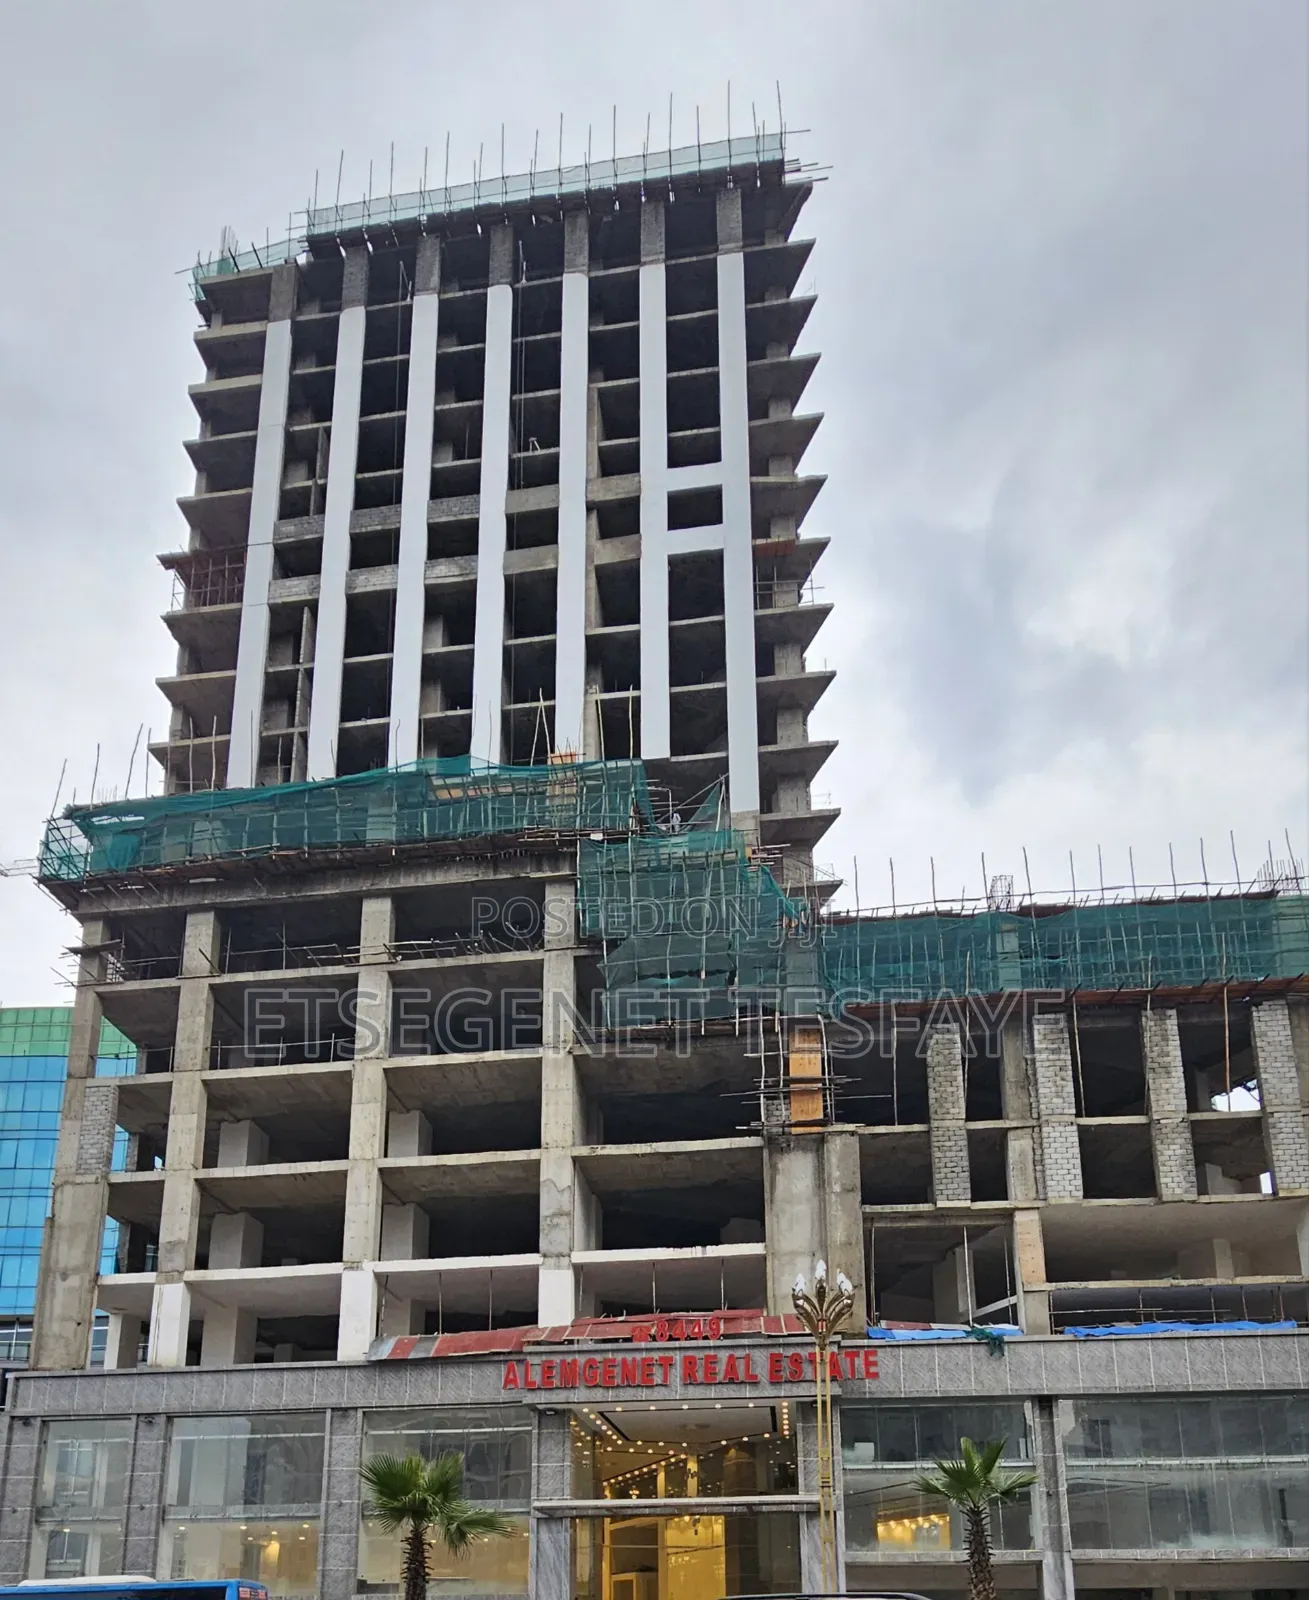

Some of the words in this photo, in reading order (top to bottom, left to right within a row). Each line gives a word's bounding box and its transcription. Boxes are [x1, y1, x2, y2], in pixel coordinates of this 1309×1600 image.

[655, 1318, 721, 1342] 8449
[502, 1355, 674, 1390] ALEMGENET
[682, 1353, 760, 1385] REAL
[768, 1349, 880, 1382] ESTATE
